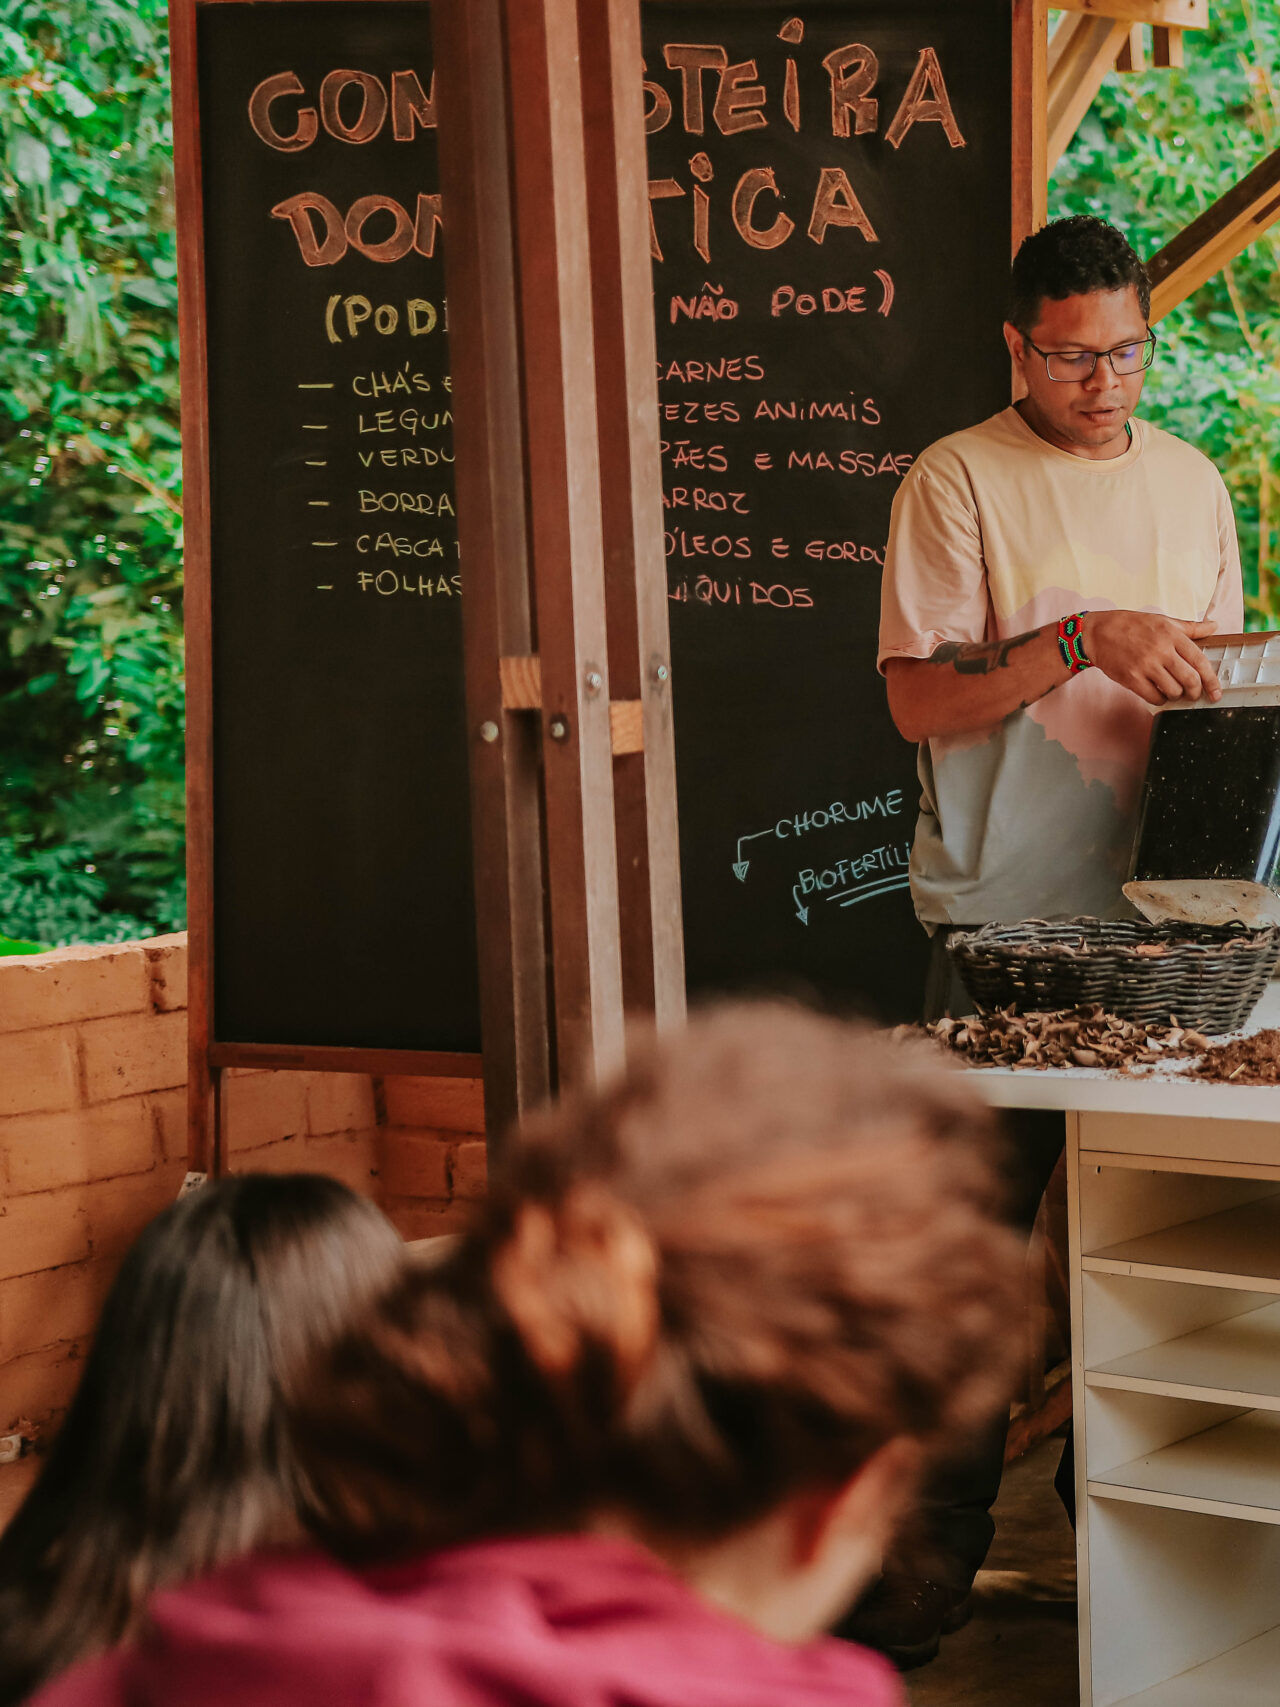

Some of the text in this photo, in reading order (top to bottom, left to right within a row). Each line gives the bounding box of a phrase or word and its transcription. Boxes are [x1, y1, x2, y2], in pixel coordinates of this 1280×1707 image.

[325, 295, 448, 343] (POD
[669, 281, 739, 324] NÃO
[656, 391, 881, 425] EZES ANIMAIS
[754, 453, 774, 471] E
[356, 533, 443, 558] CASCA
[771, 537, 790, 559] E
[775, 789, 903, 839] CHORUME
